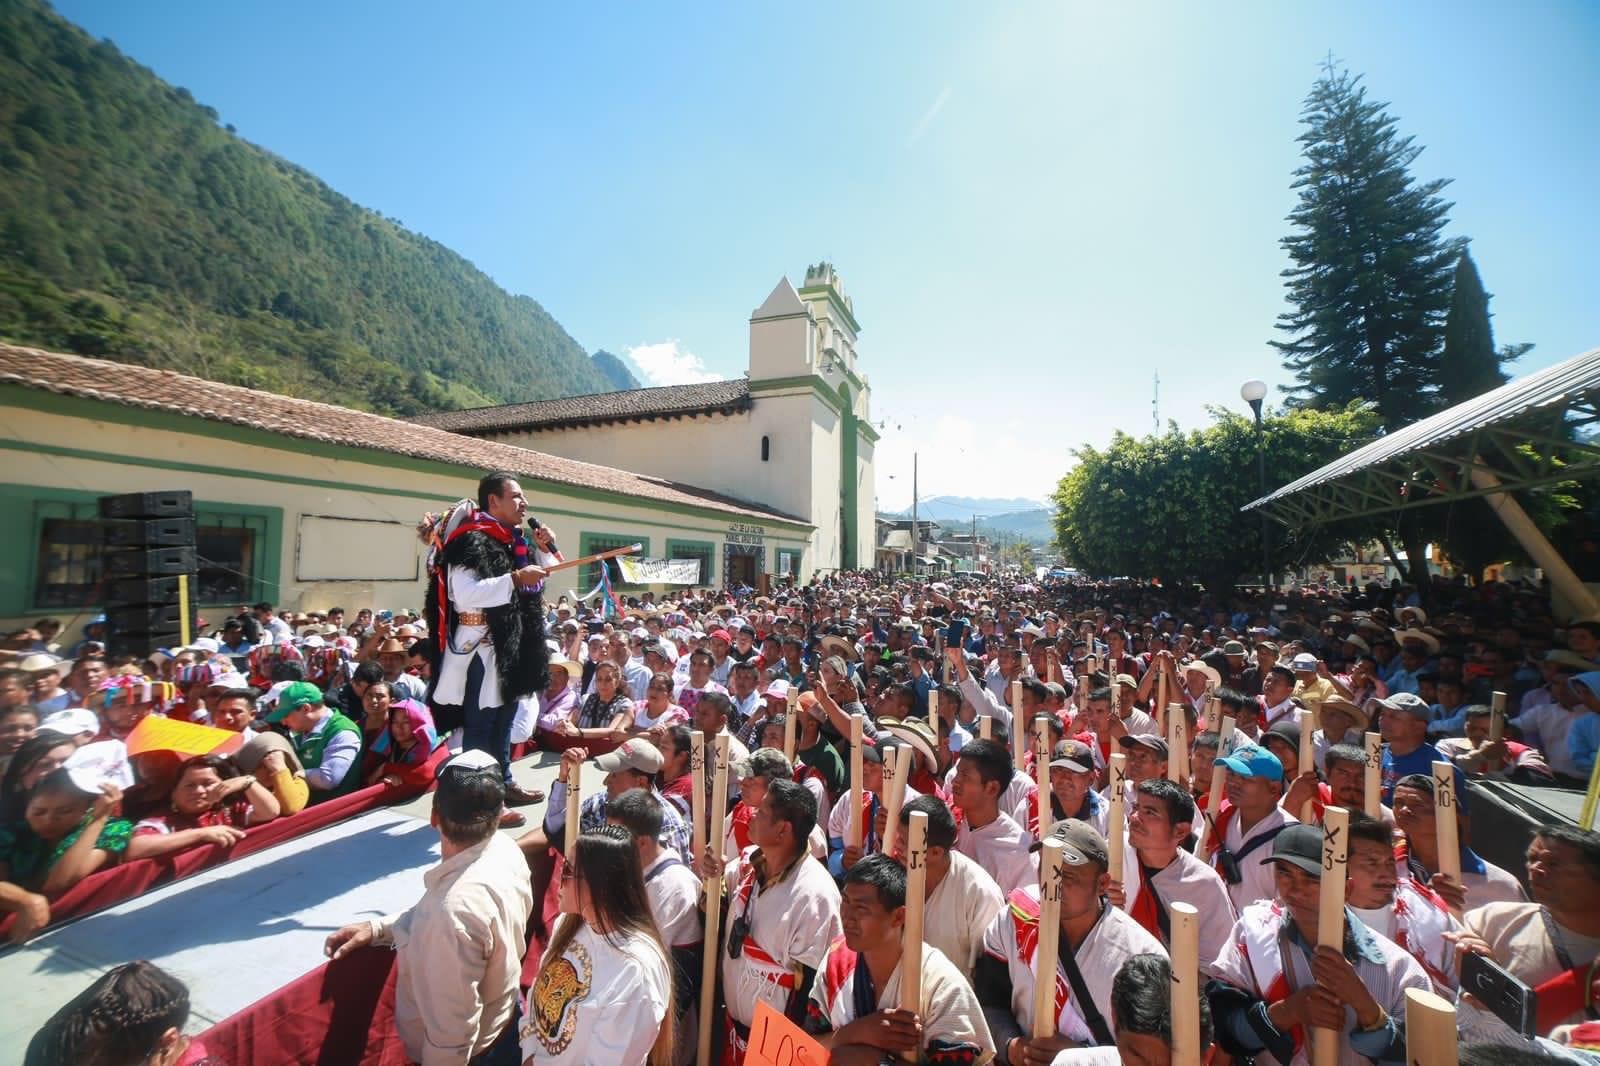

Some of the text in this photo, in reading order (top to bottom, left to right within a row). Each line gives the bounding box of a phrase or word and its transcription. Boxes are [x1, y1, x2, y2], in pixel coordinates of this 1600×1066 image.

[1115, 767, 1125, 781] X
[1436, 775, 1450, 788] X
[1324, 824, 1340, 845] X
